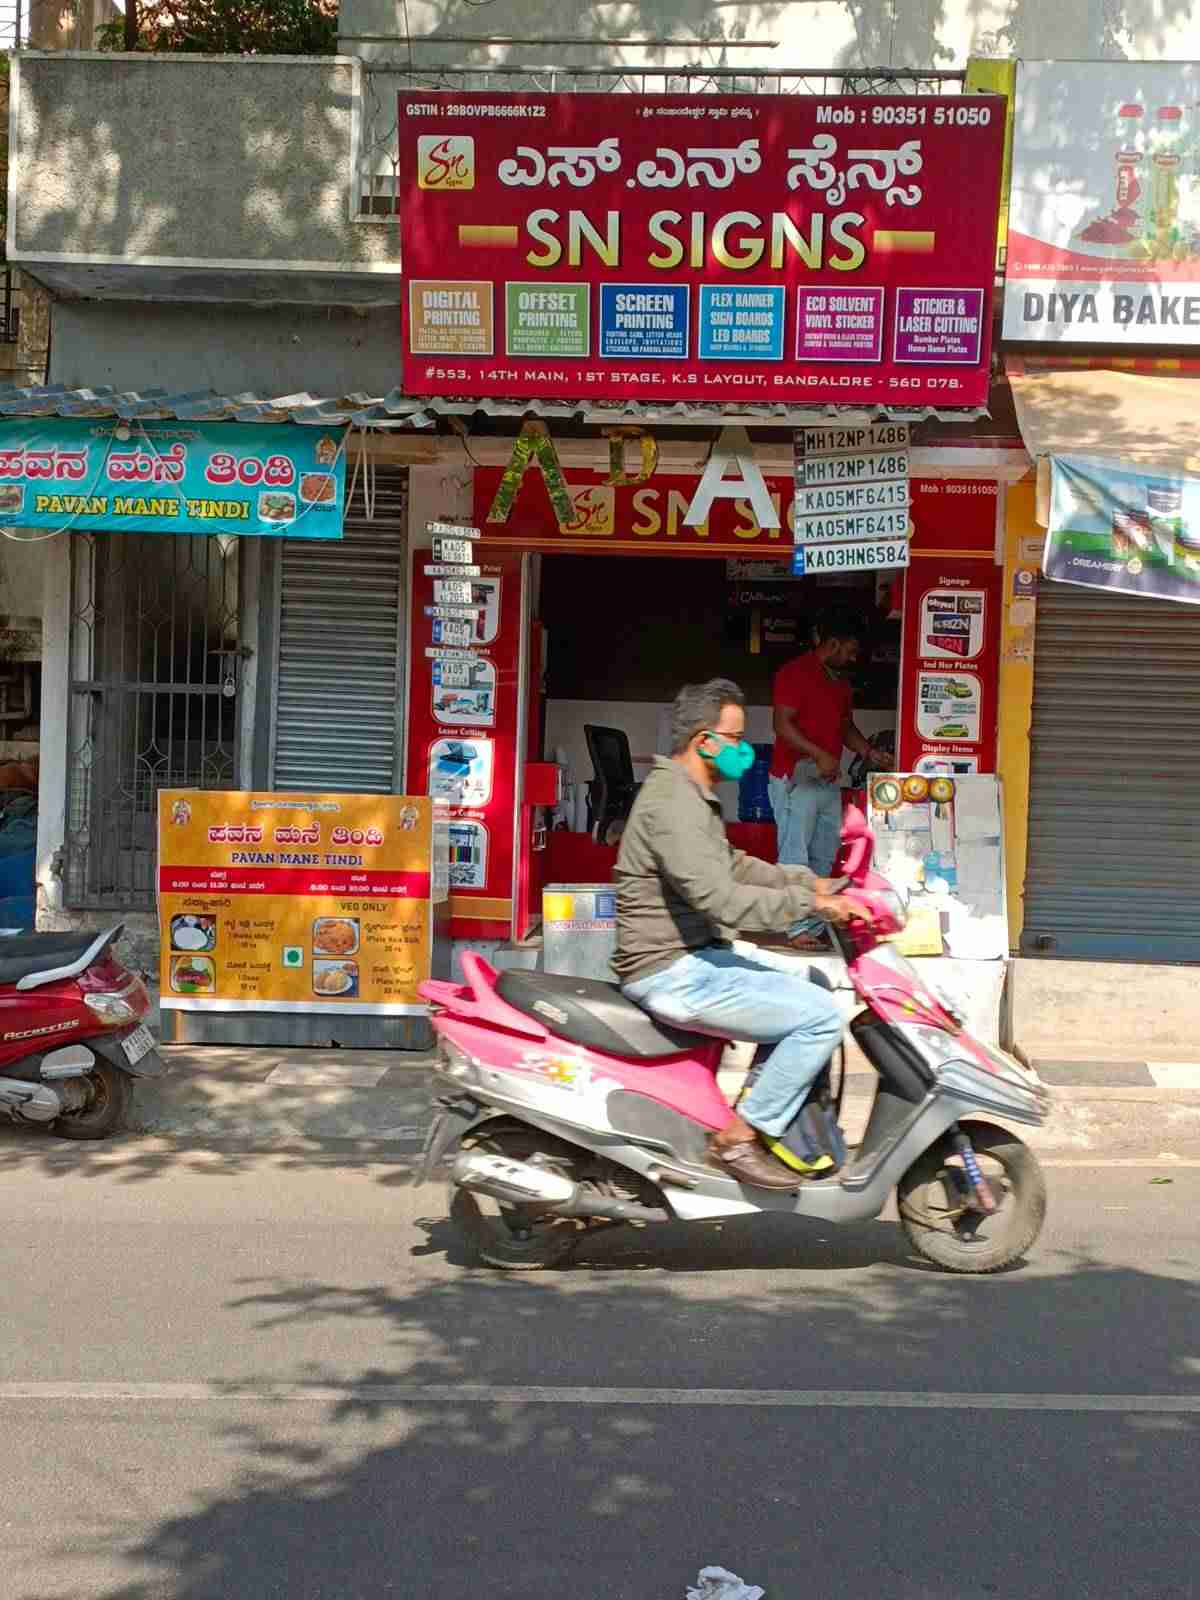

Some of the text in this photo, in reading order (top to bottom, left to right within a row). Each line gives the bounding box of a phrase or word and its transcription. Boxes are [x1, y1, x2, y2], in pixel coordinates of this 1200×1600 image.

[406, 104, 437, 116] GSTIN
[816, 106, 854, 124] Mob
[872, 107, 926, 124] 90351
[933, 107, 990, 126] 51050
[526, 208, 866, 271] SN SIGNS
[422, 291, 481, 310] DIGITAL
[518, 292, 577, 311] OFFSET
[615, 293, 674, 312] SCREEN
[711, 293, 774, 308] FLEX BANNER
[806, 296, 875, 312] ECO SOLVENT
[913, 298, 966, 315] STICKER &
[1023, 291, 1099, 324] DIYA
[423, 311, 481, 326] PRINTING
[518, 312, 577, 328] PRINTING
[615, 314, 674, 329] PRINTING
[710, 311, 774, 326] SIGN BOARDS
[805, 314, 874, 329] VINYL STICKER
[900, 316, 977, 333] LASER CUTTING
[713, 328, 770, 343] LED BOARDS
[425, 366, 472, 380] #553,
[479, 369, 518, 380] 14TH
[524, 370, 569, 382] MAIN,
[576, 371, 605, 382] 1ST
[610, 372, 666, 384] STAGE,
[671, 373, 697, 384] K.S
[704, 374, 768, 387] LAYOUT,
[773, 375, 873, 387] BANGALORE
[889, 377, 921, 388] 560
[805, 426, 906, 450] MH12NP1486
[107, 443, 186, 483] ಮನೆ
[205, 453, 295, 485] ತಿಂಡಿ
[805, 456, 906, 480] MH12NP1486
[805, 485, 906, 509] KA05MF6415
[920, 484, 939, 494] Mob
[36, 495, 249, 519] PAVAN MANE TINDI
[805, 514, 906, 538] KA05MF6415
[805, 543, 907, 568] KA03HN6584
[208, 821, 384, 847] ಪವನ ಮನೆ ತಿಂಡಿ
[232, 853, 363, 866] PAVAN MANE TINDI
[361, 903, 388, 913] ONLY
